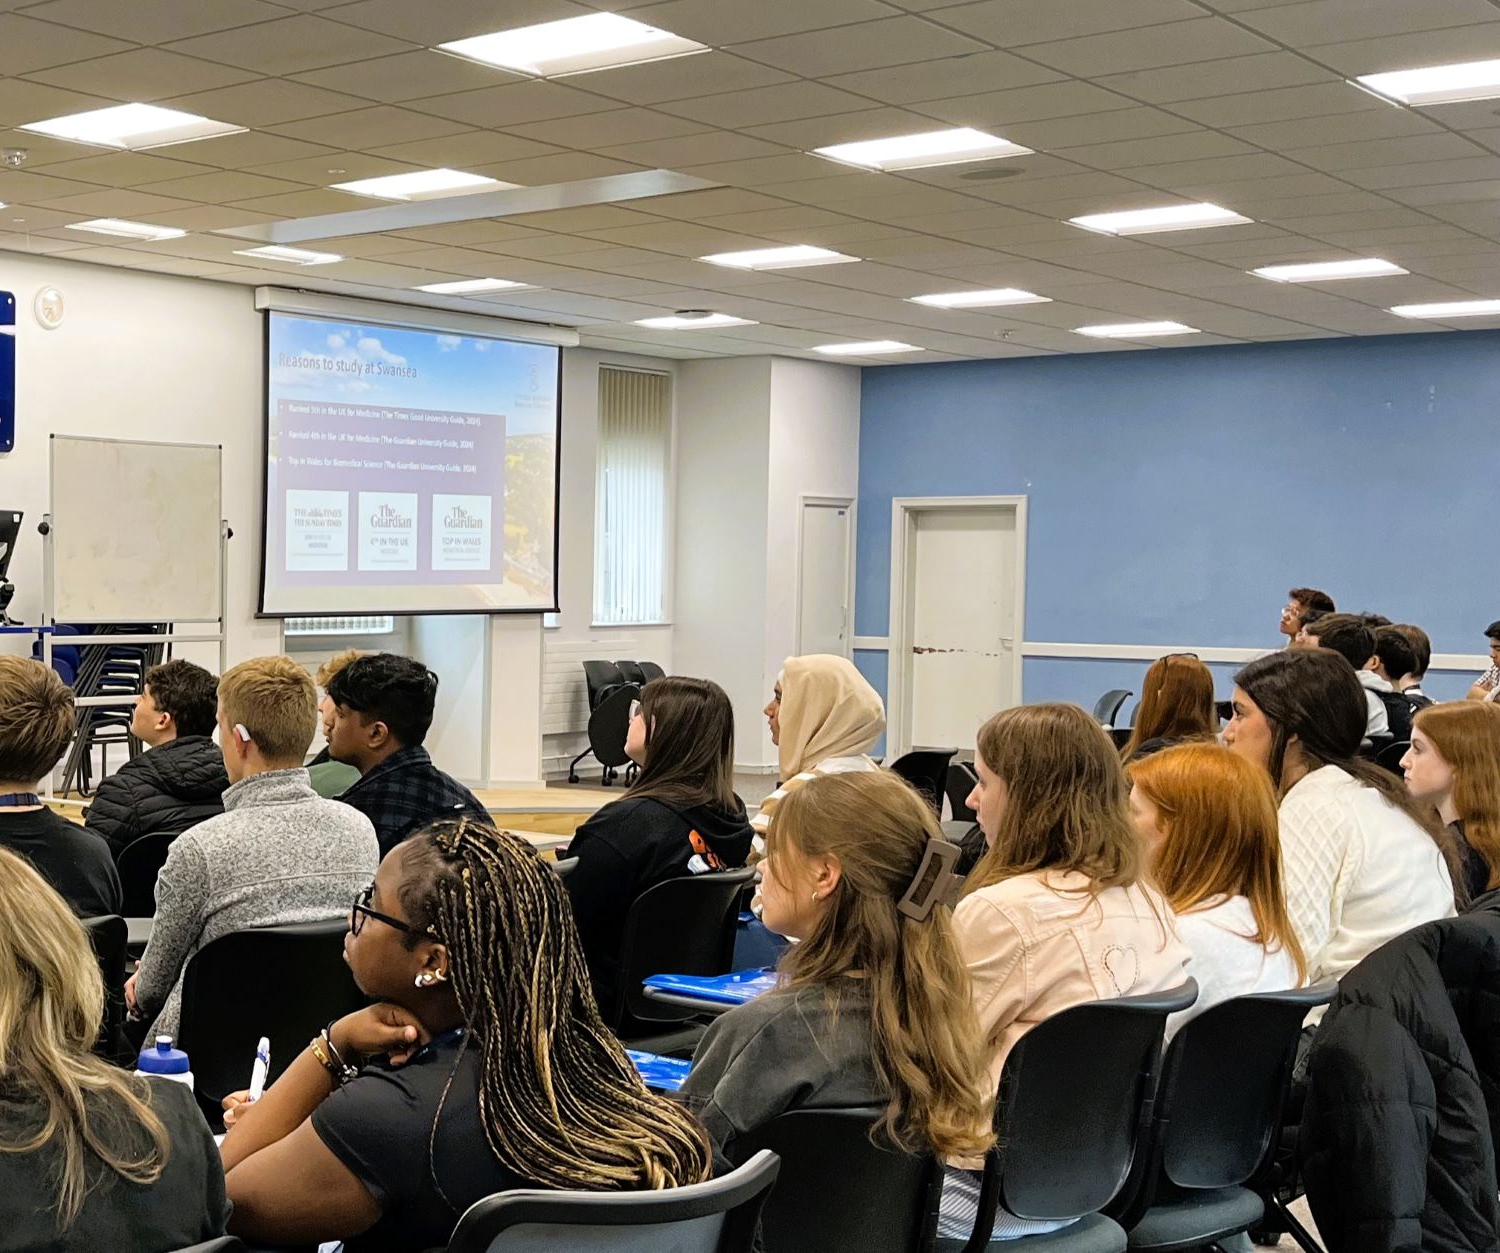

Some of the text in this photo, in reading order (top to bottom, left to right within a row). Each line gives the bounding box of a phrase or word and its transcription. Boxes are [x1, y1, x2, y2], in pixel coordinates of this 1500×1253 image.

[279, 352, 417, 378] Reasons to study at Swansea
[379, 504, 396, 518] The
[452, 505, 468, 519] The
[370, 513, 412, 529] Guardian
[444, 515, 483, 529] Guardian
